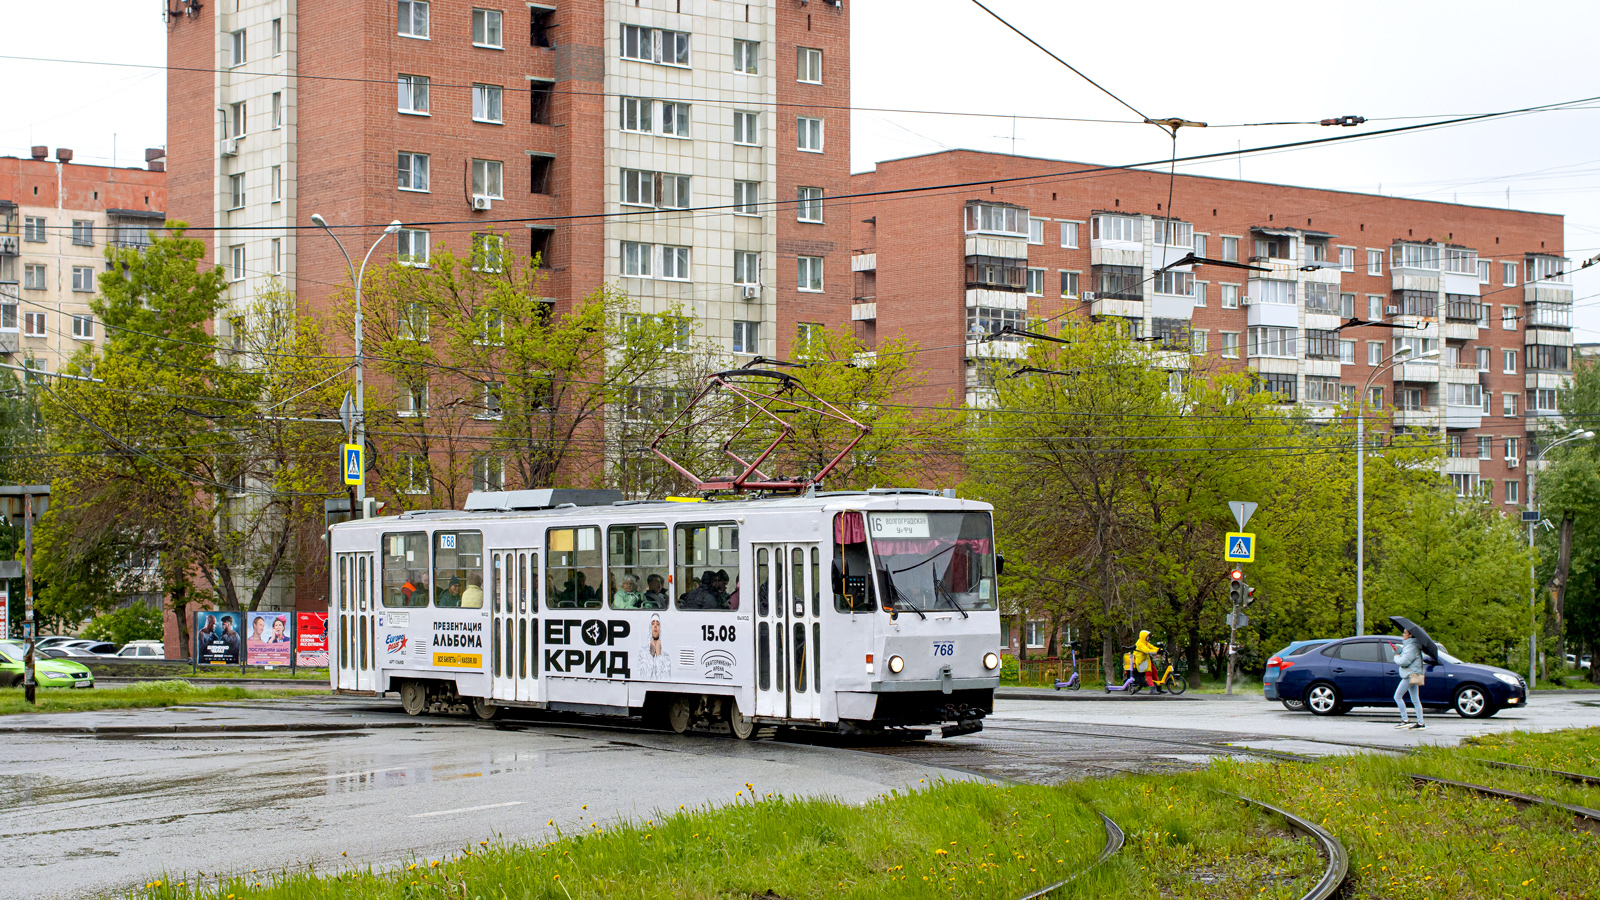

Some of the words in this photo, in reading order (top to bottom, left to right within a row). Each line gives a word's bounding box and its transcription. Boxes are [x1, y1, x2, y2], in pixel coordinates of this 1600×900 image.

[871, 517, 883, 532] 16
[442, 536, 454, 548] 768
[433, 621, 482, 633] ПРЕЗЕНТАЦИЯ
[544, 619, 631, 646] ЕГОР
[701, 624, 737, 643] 15.08
[432, 633, 483, 648] АЛЬБОМА
[933, 644, 954, 656] 768
[544, 649, 631, 679] КРИД
